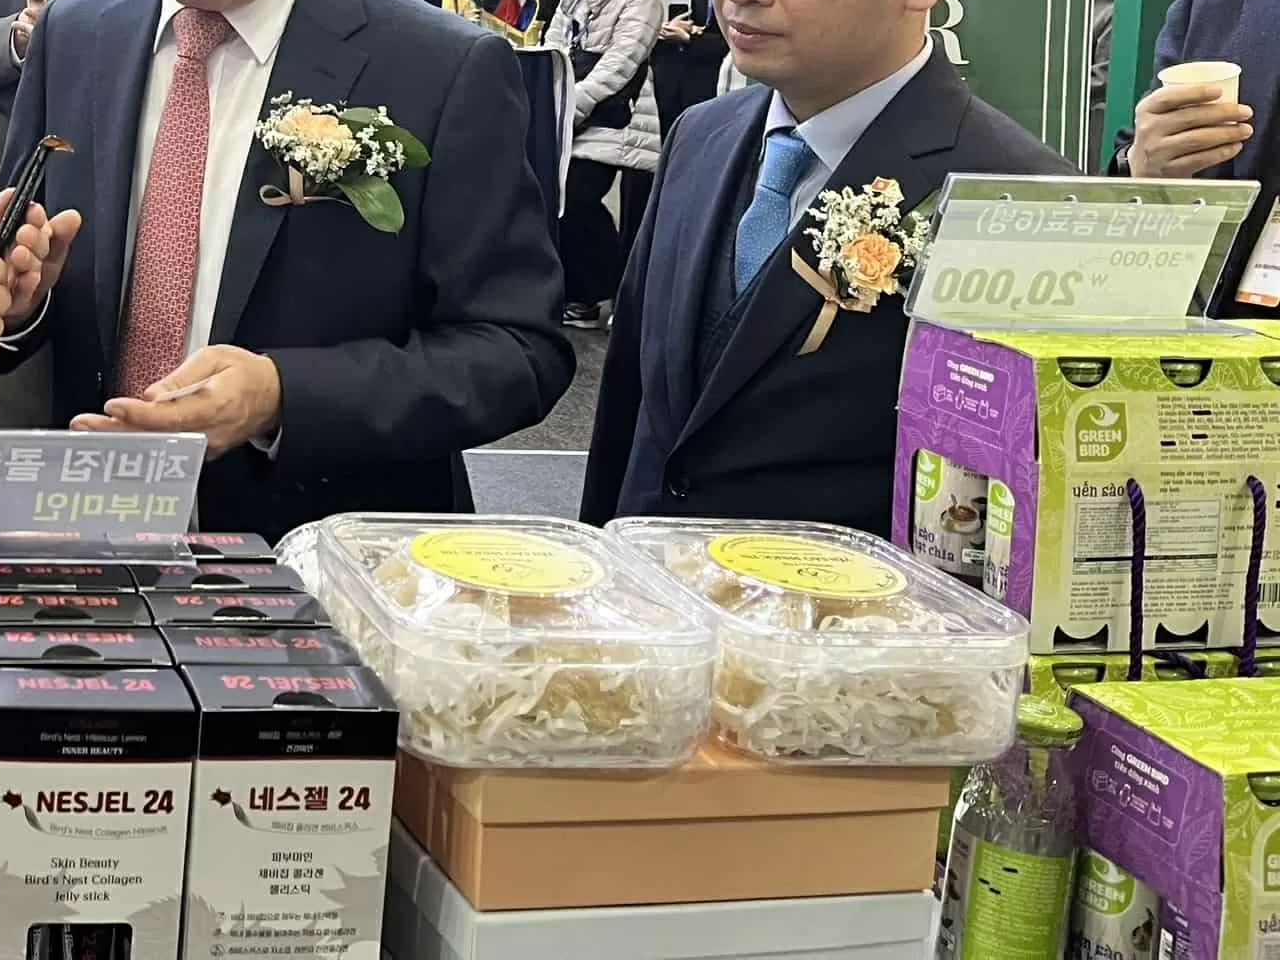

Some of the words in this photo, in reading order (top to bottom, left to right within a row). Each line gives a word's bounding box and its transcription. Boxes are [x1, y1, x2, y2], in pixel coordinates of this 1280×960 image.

[1078, 429, 1122, 443] GREEN
[1078, 444, 1111, 457] BIRD
[1101, 484, 1125, 497] sào
[194, 635, 288, 649] NESJEL
[291, 636, 322, 649] 24
[17, 677, 118, 690] NESJEL
[122, 678, 156, 692] 24
[221, 674, 255, 690] 24
[257, 675, 356, 690] NESJEL
[36, 791, 136, 813] NESJEL
[143, 790, 175, 814] 24
[249, 786, 329, 811] 네스젤
[338, 786, 371, 811] 24
[50, 856, 76, 869] Skin
[79, 856, 120, 871] Beauty
[271, 851, 313, 863] 피부미인
[24, 873, 59, 886] Bird's
[62, 874, 88, 886] Nest
[91, 873, 143, 886] Collagen
[55, 890, 80, 903] Jelly
[82, 890, 111, 902] stick
